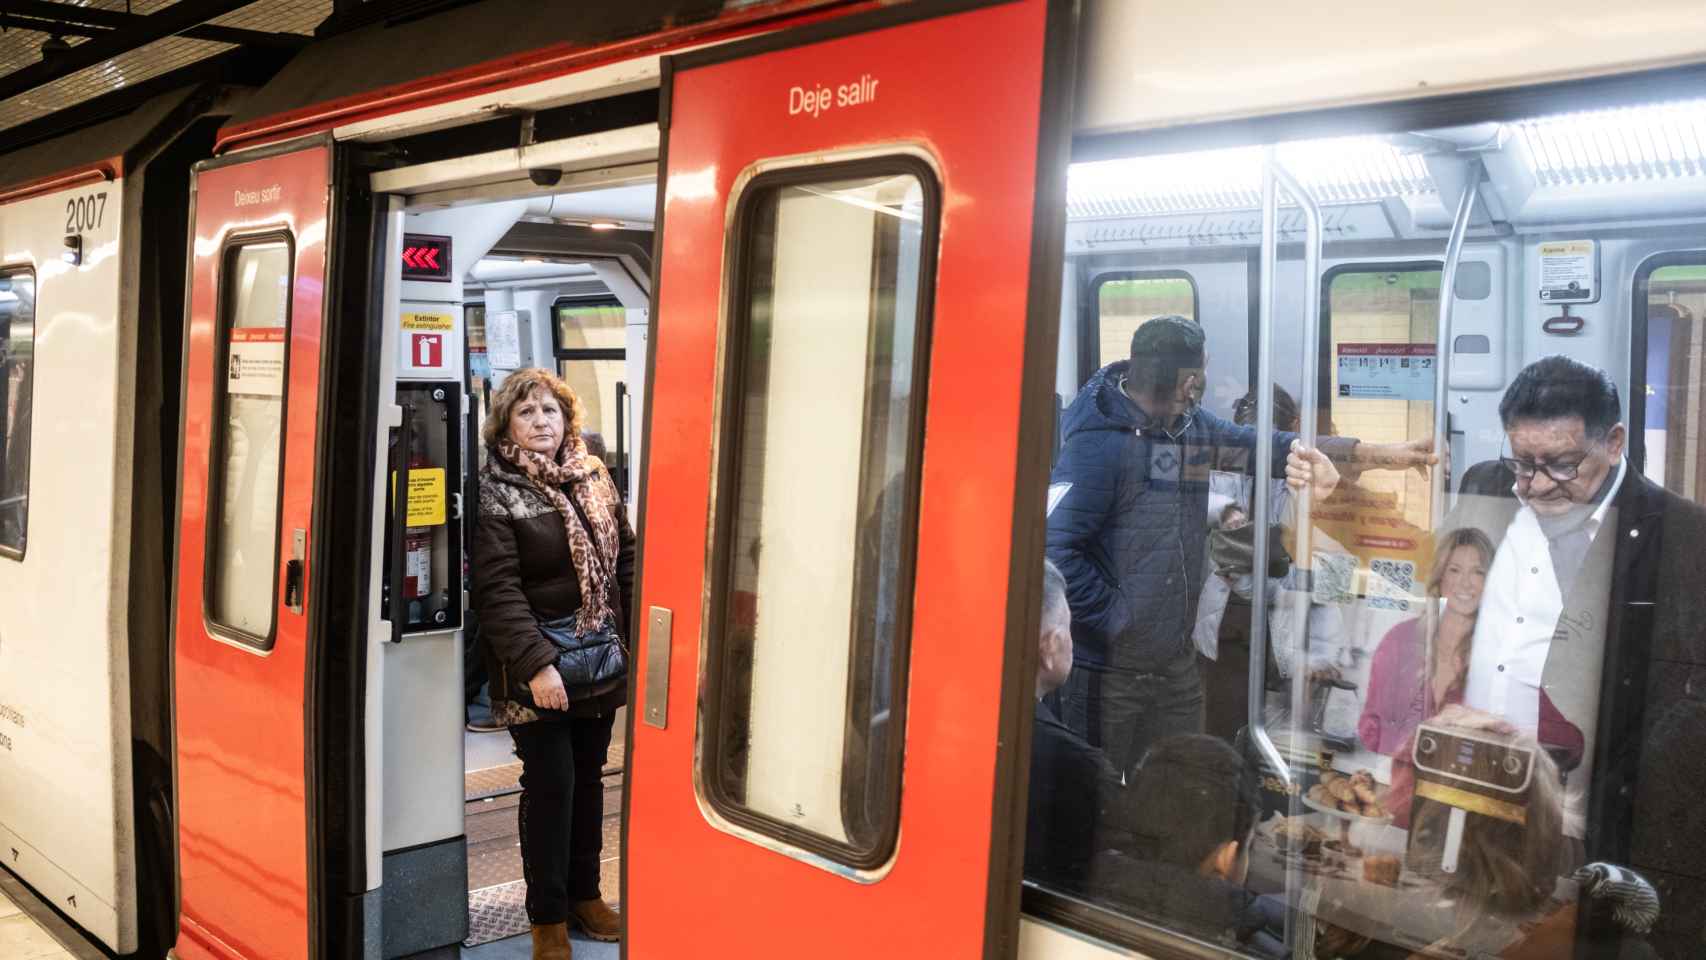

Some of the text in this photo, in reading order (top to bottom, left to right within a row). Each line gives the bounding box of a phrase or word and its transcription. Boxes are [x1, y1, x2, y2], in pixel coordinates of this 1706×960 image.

[788, 73, 879, 118] Deje salir
[66, 192, 107, 233] 2007
